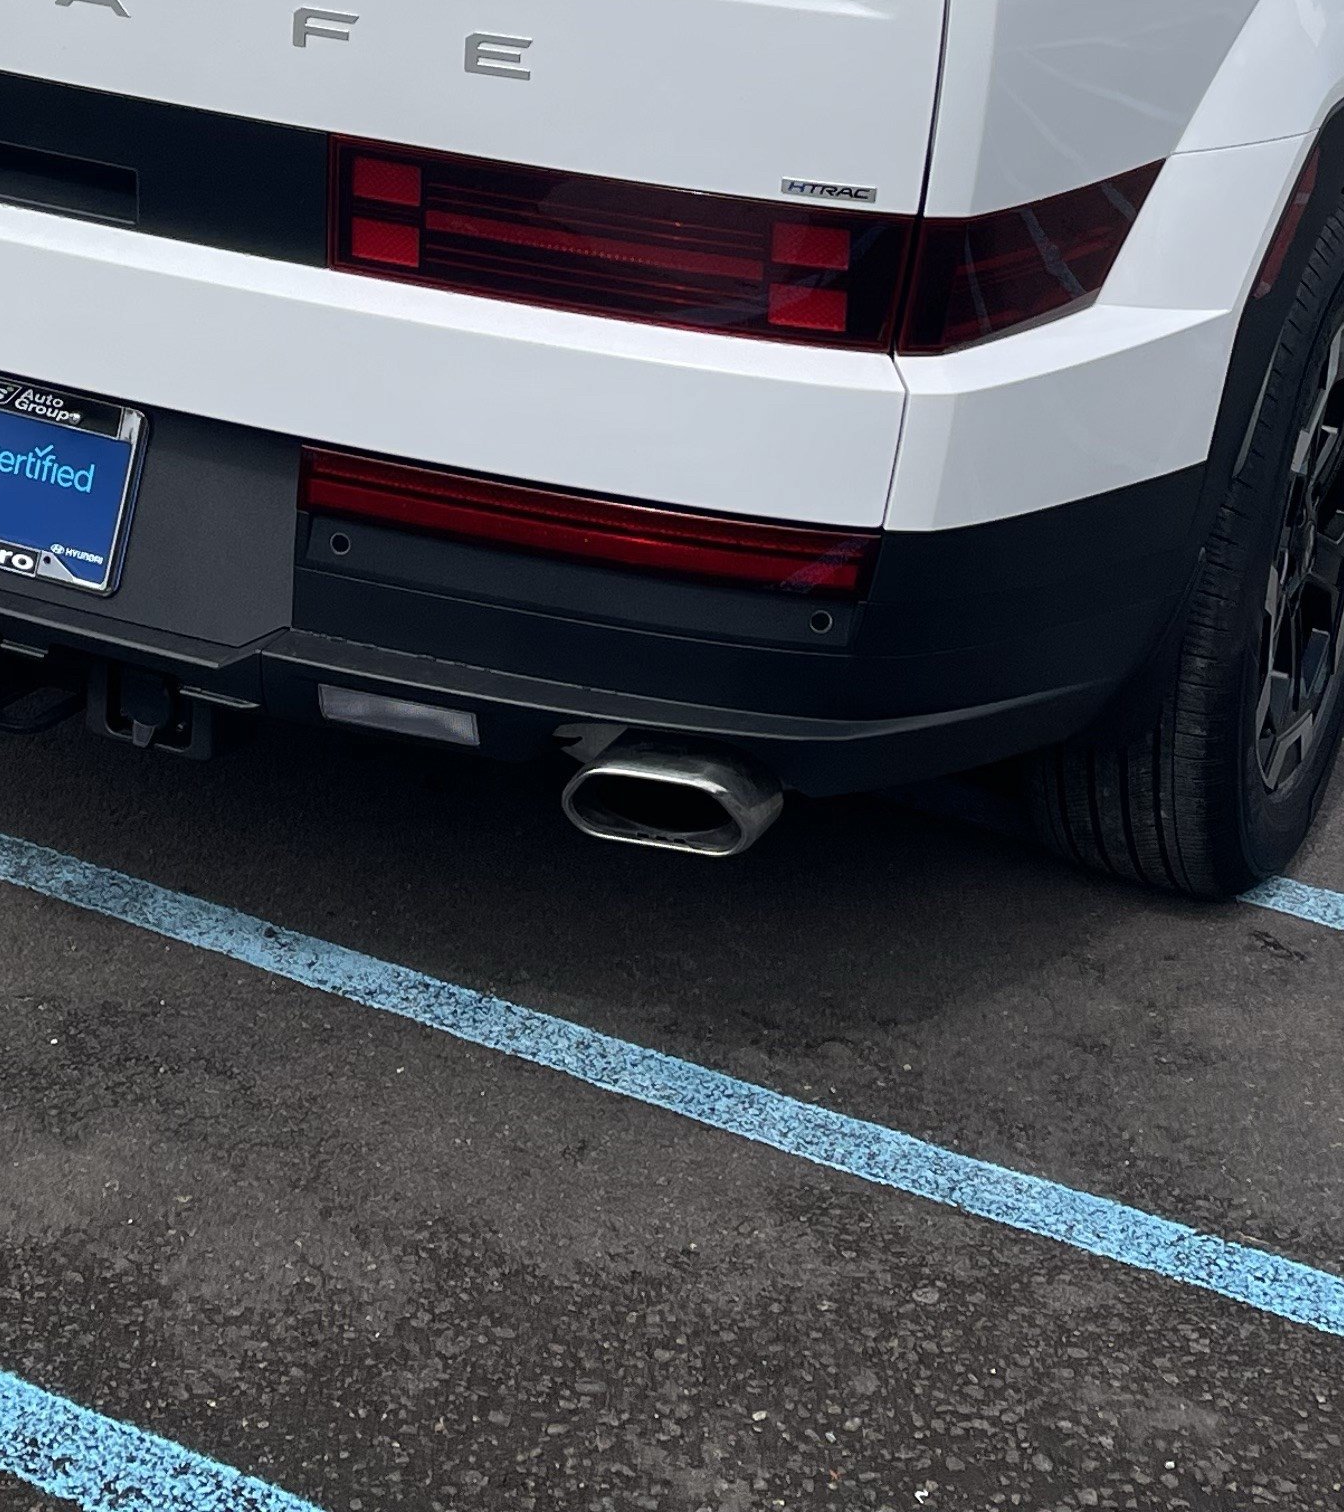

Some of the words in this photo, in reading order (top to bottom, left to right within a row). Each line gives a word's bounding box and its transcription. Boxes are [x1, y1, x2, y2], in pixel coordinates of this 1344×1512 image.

[293, 6, 533, 81] FE
[787, 181, 871, 200] HTRAC
[19, 389, 64, 409] Auto
[14, 398, 71, 423] Group
[64, 546, 104, 566] HYUNDAI
